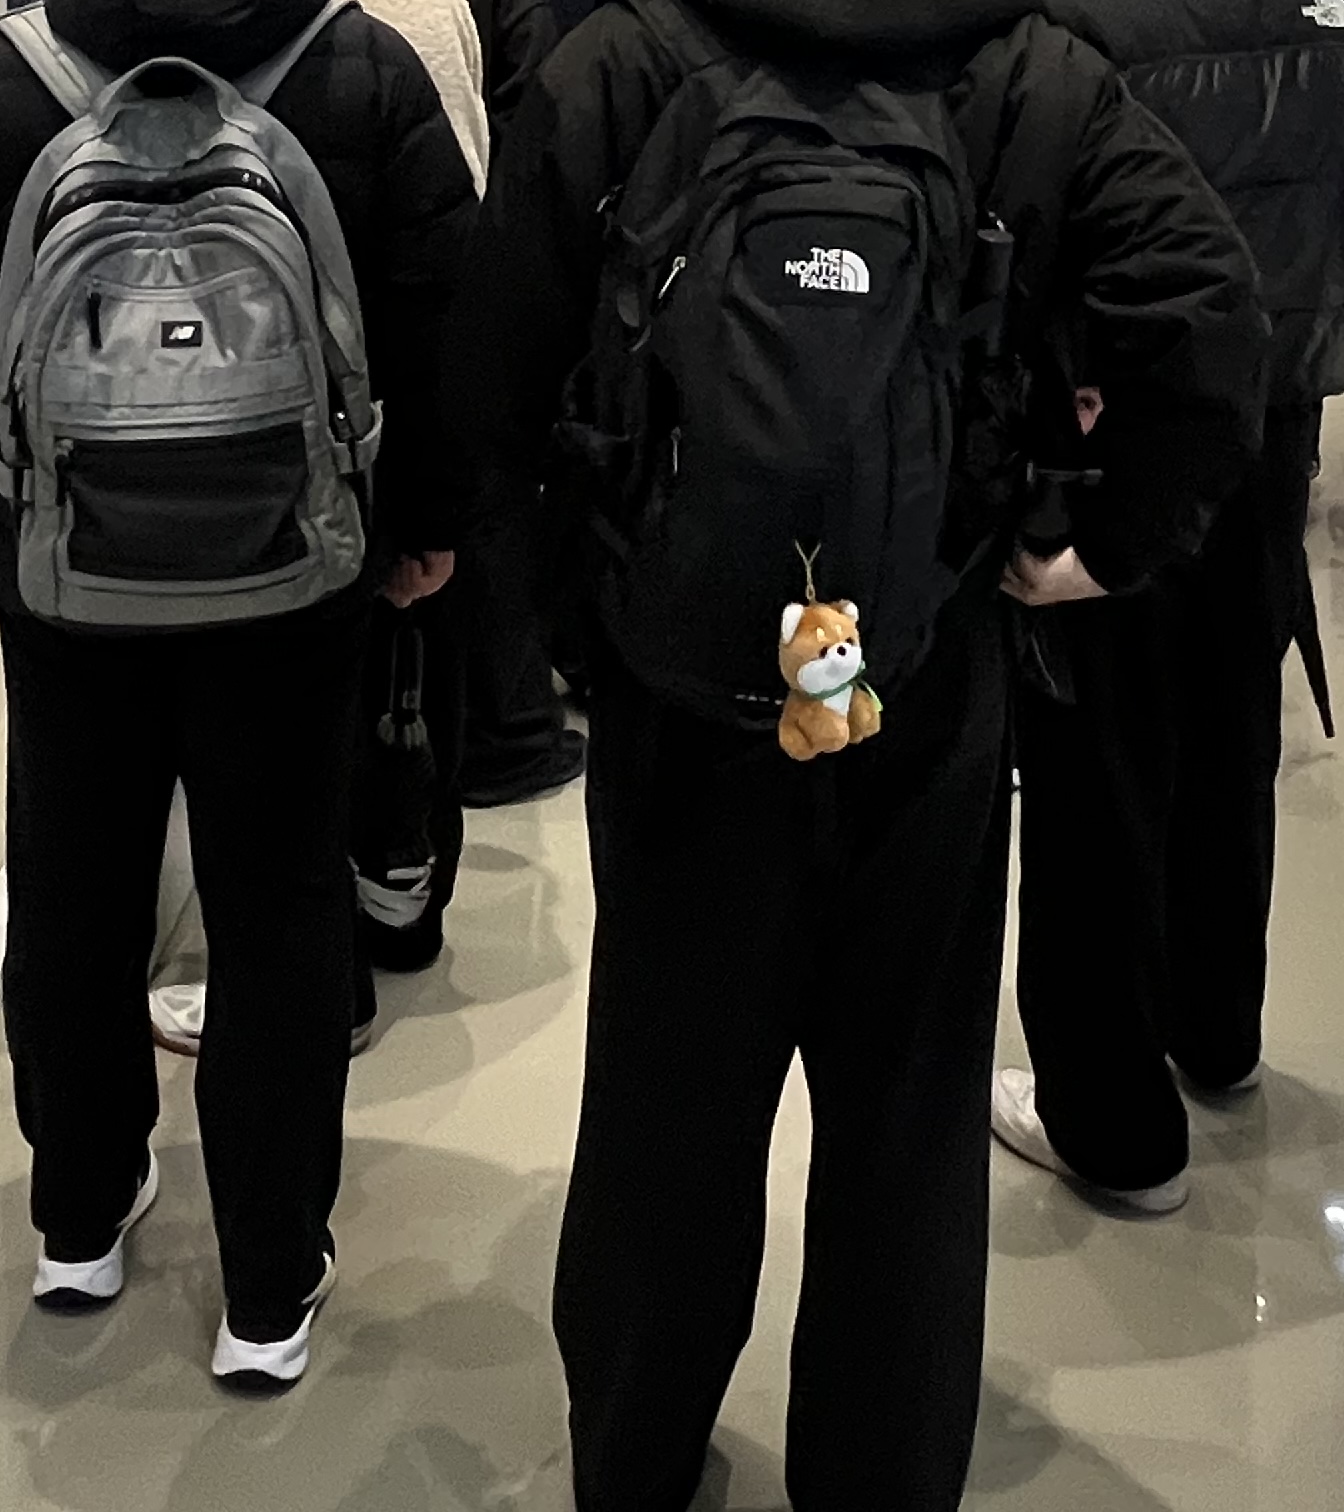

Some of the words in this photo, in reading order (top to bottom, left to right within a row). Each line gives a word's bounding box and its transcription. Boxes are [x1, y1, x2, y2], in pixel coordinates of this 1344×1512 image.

[810, 247, 841, 262] THE
[785, 260, 840, 276] NORTH
[800, 275, 841, 289] FACE
